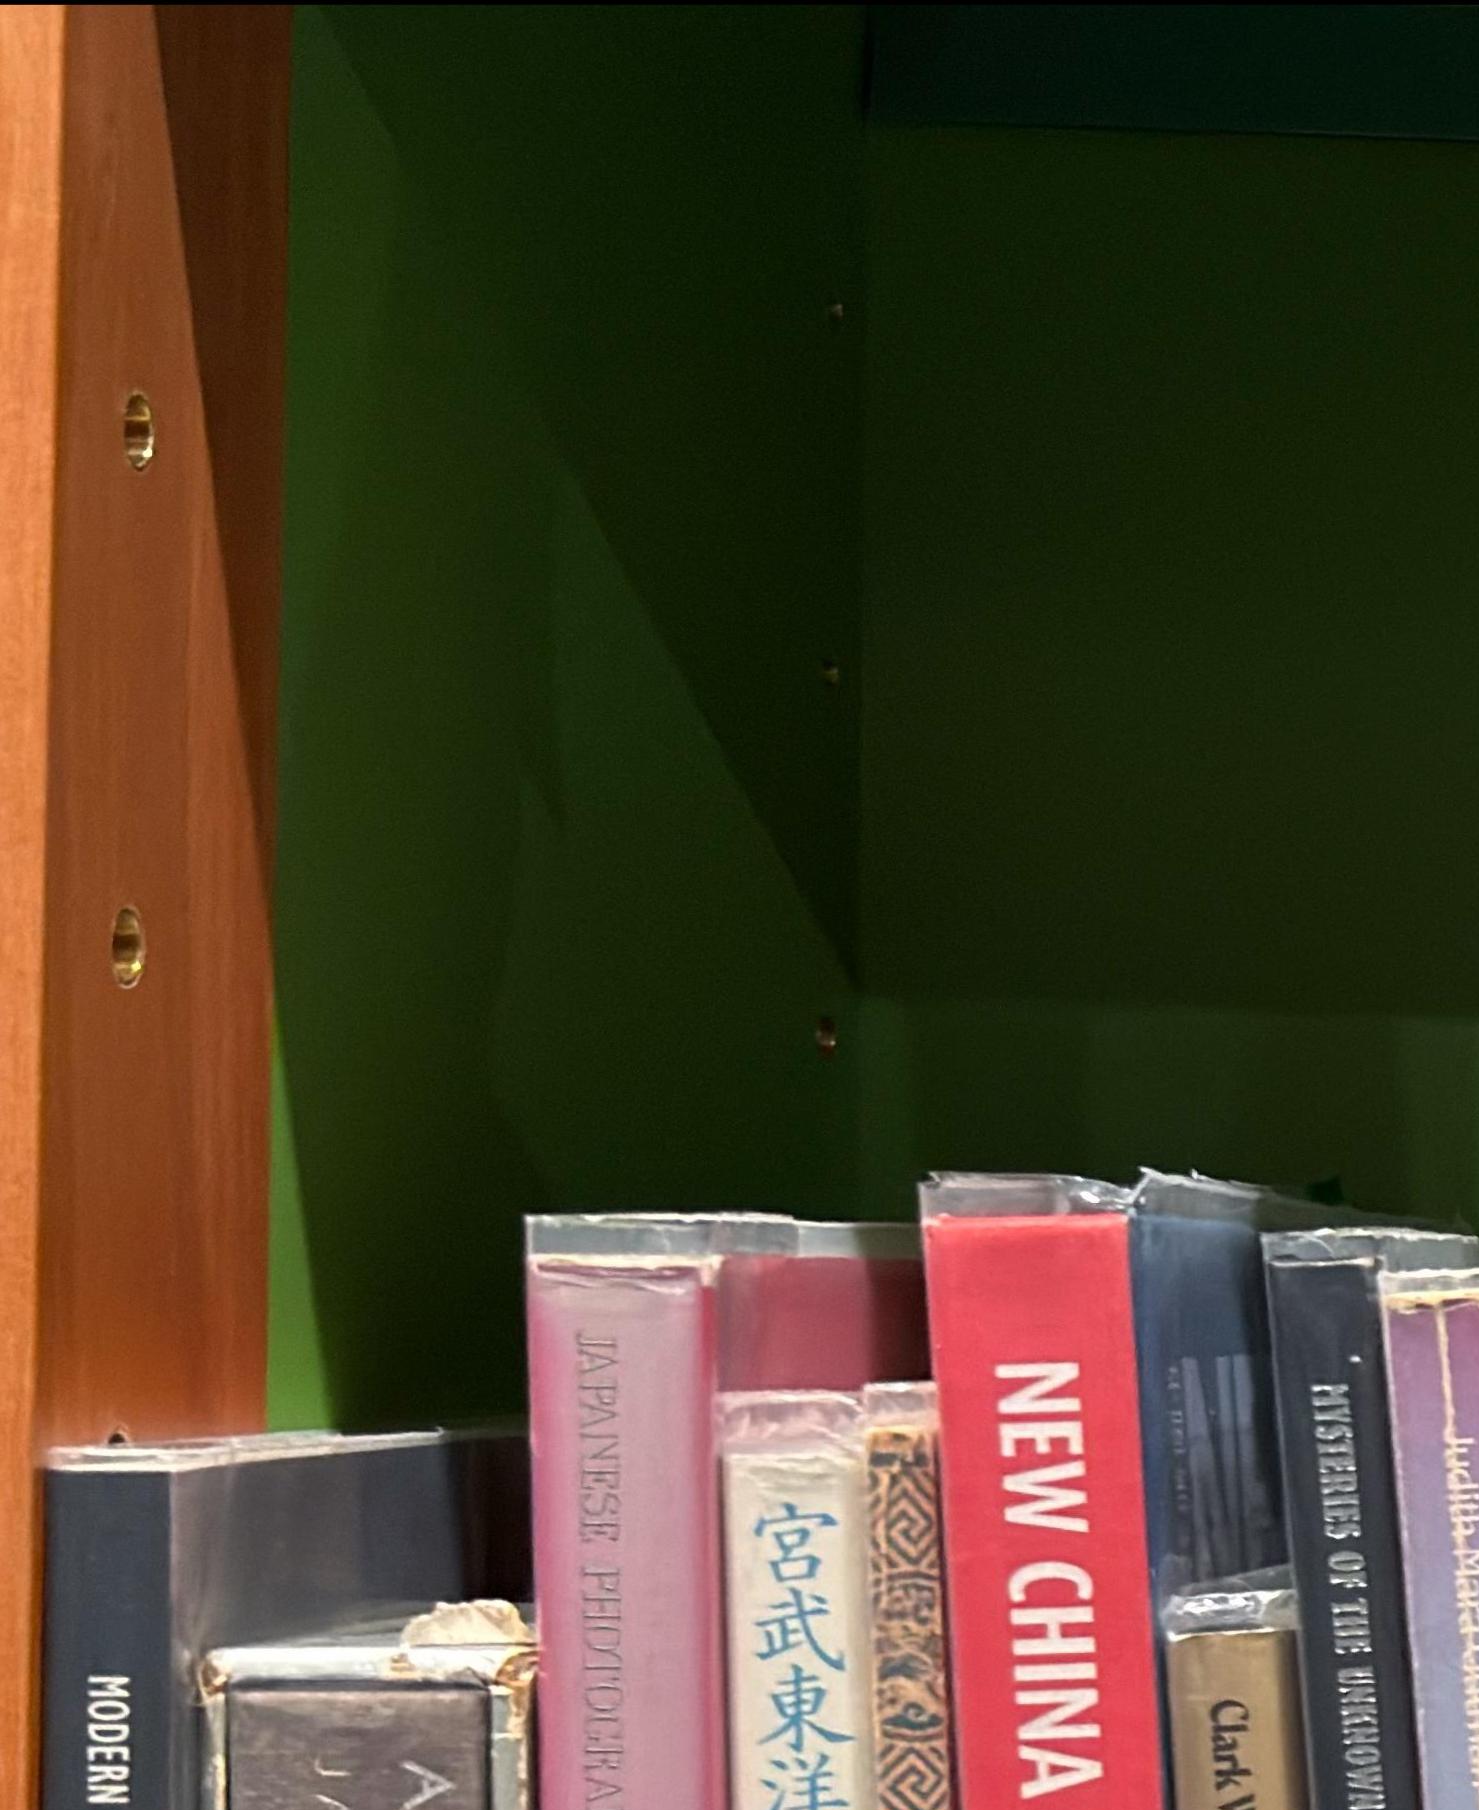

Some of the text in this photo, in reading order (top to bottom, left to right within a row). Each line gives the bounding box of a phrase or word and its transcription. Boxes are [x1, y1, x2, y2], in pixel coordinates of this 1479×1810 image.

[996, 1361, 1089, 1535] NEW
[1310, 1384, 1358, 1544] MYSTERIES
[1330, 1551, 1366, 1592] OF
[1333, 1597, 1373, 1653] THE
[87, 1675, 131, 1807] MODERN
[1011, 1562, 1104, 1801] CHINA
[1207, 1699, 1252, 1790] Clark
